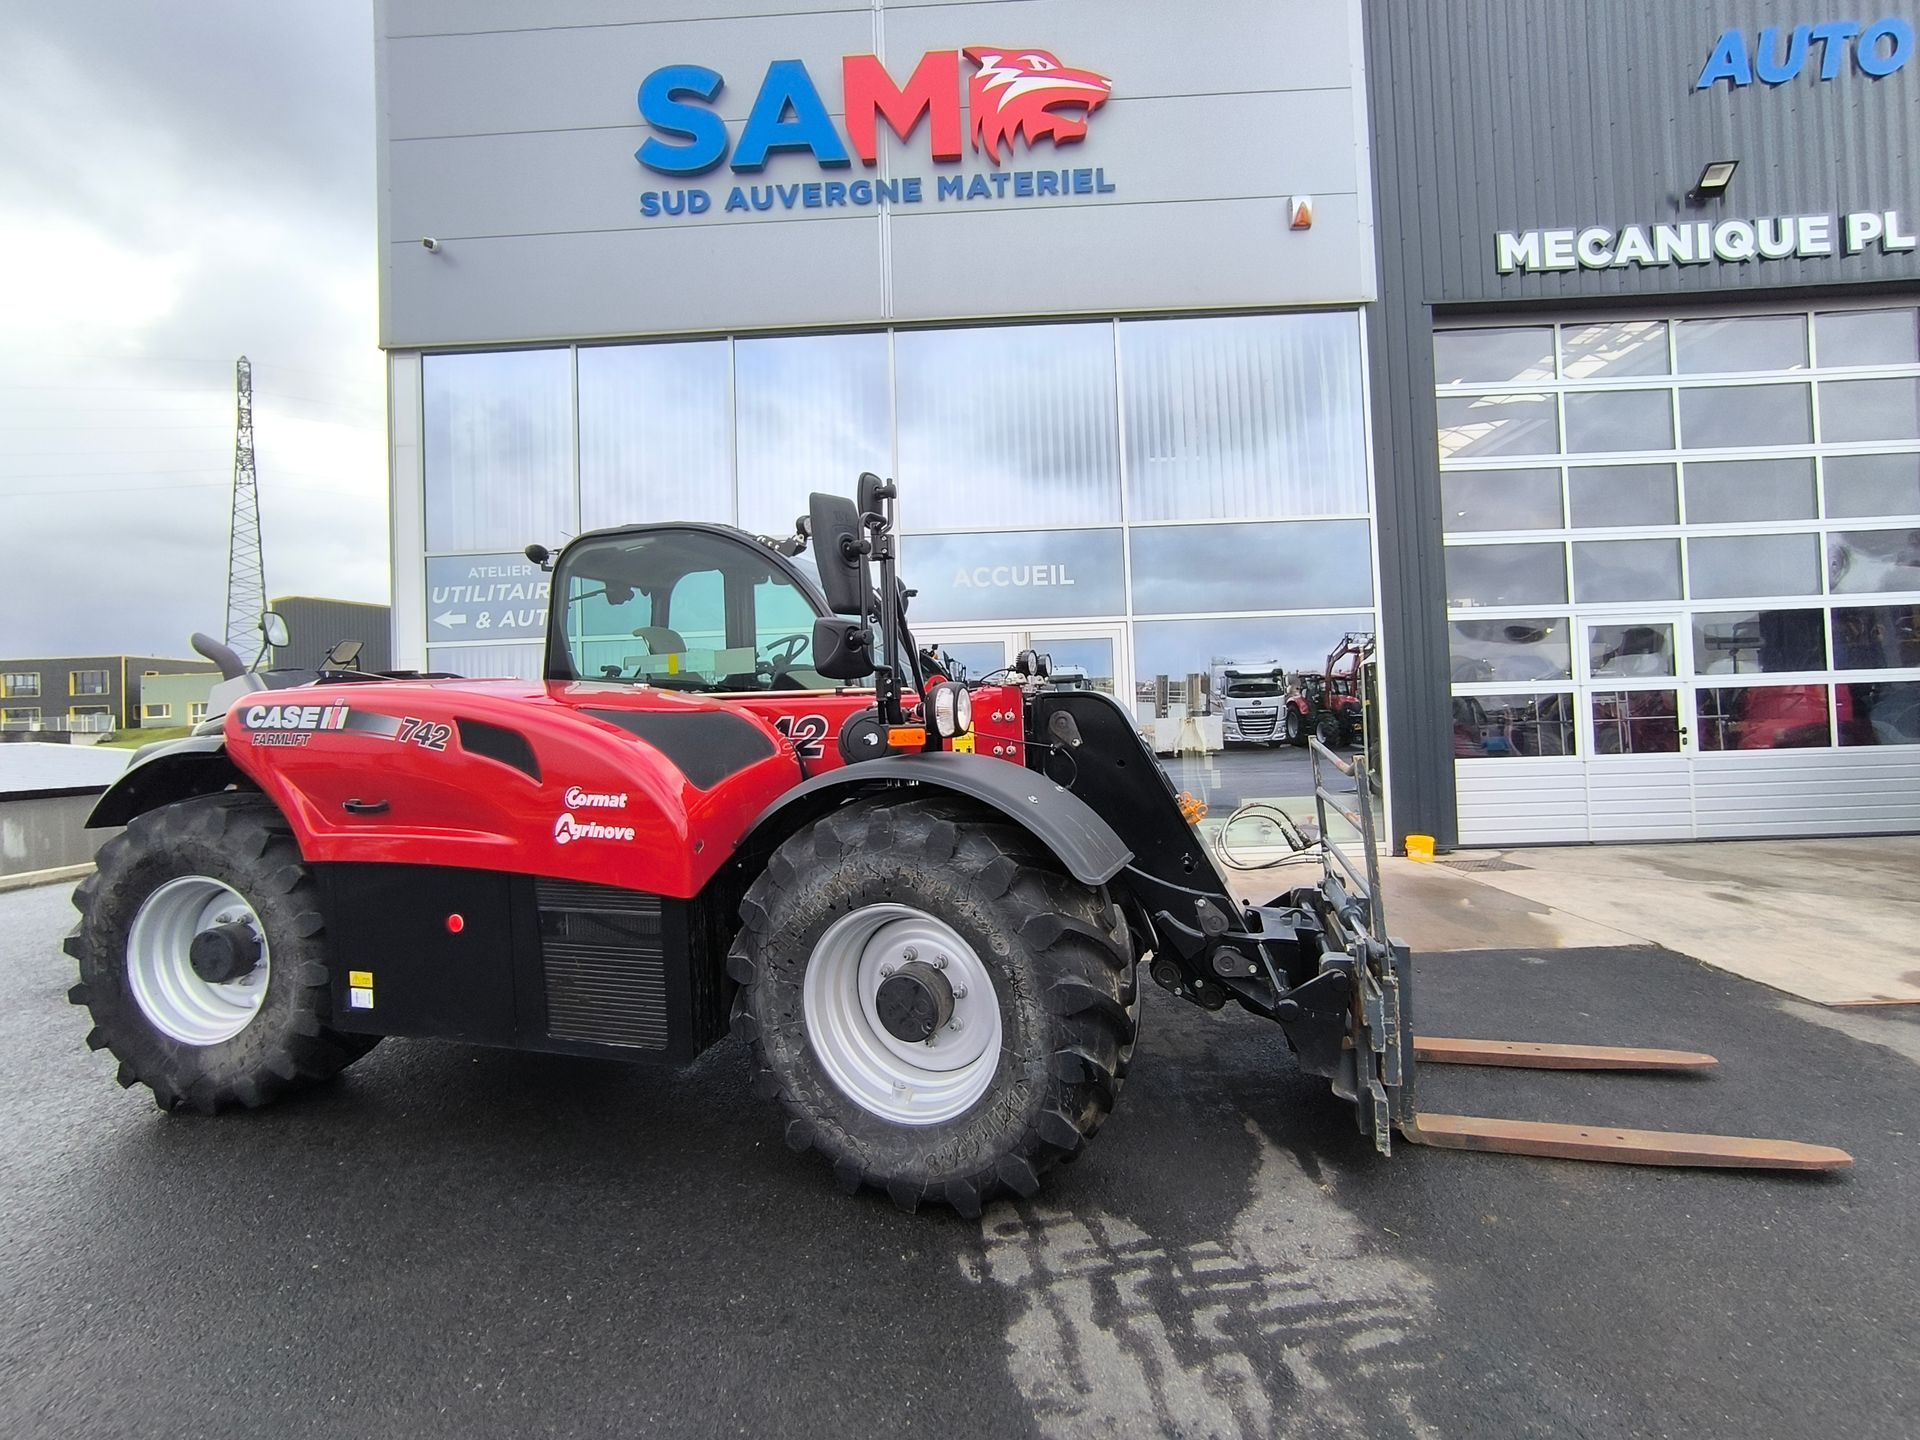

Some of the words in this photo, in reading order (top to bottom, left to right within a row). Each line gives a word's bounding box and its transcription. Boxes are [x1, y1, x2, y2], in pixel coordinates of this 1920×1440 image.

[1695, 17, 1915, 88] AUTO
[634, 49, 963, 178] SAM
[639, 189, 711, 216] SUD
[725, 177, 922, 211] AUVERGNE
[937, 167, 1116, 200] MATERIEL
[1497, 216, 1831, 273] MECANIQUE
[1847, 210, 1917, 253] PL
[468, 565, 532, 579] ATELIER
[952, 564, 1075, 588] ACCUEIL
[432, 582, 550, 604] UTILITAIR
[476, 610, 492, 629] &
[498, 608, 548, 628] AUT
[245, 705, 321, 730] CASE
[251, 733, 312, 747] FARMLIFT
[400, 717, 452, 751] 742
[564, 785, 628, 809] Cormat
[554, 812, 635, 845] Agrinove
